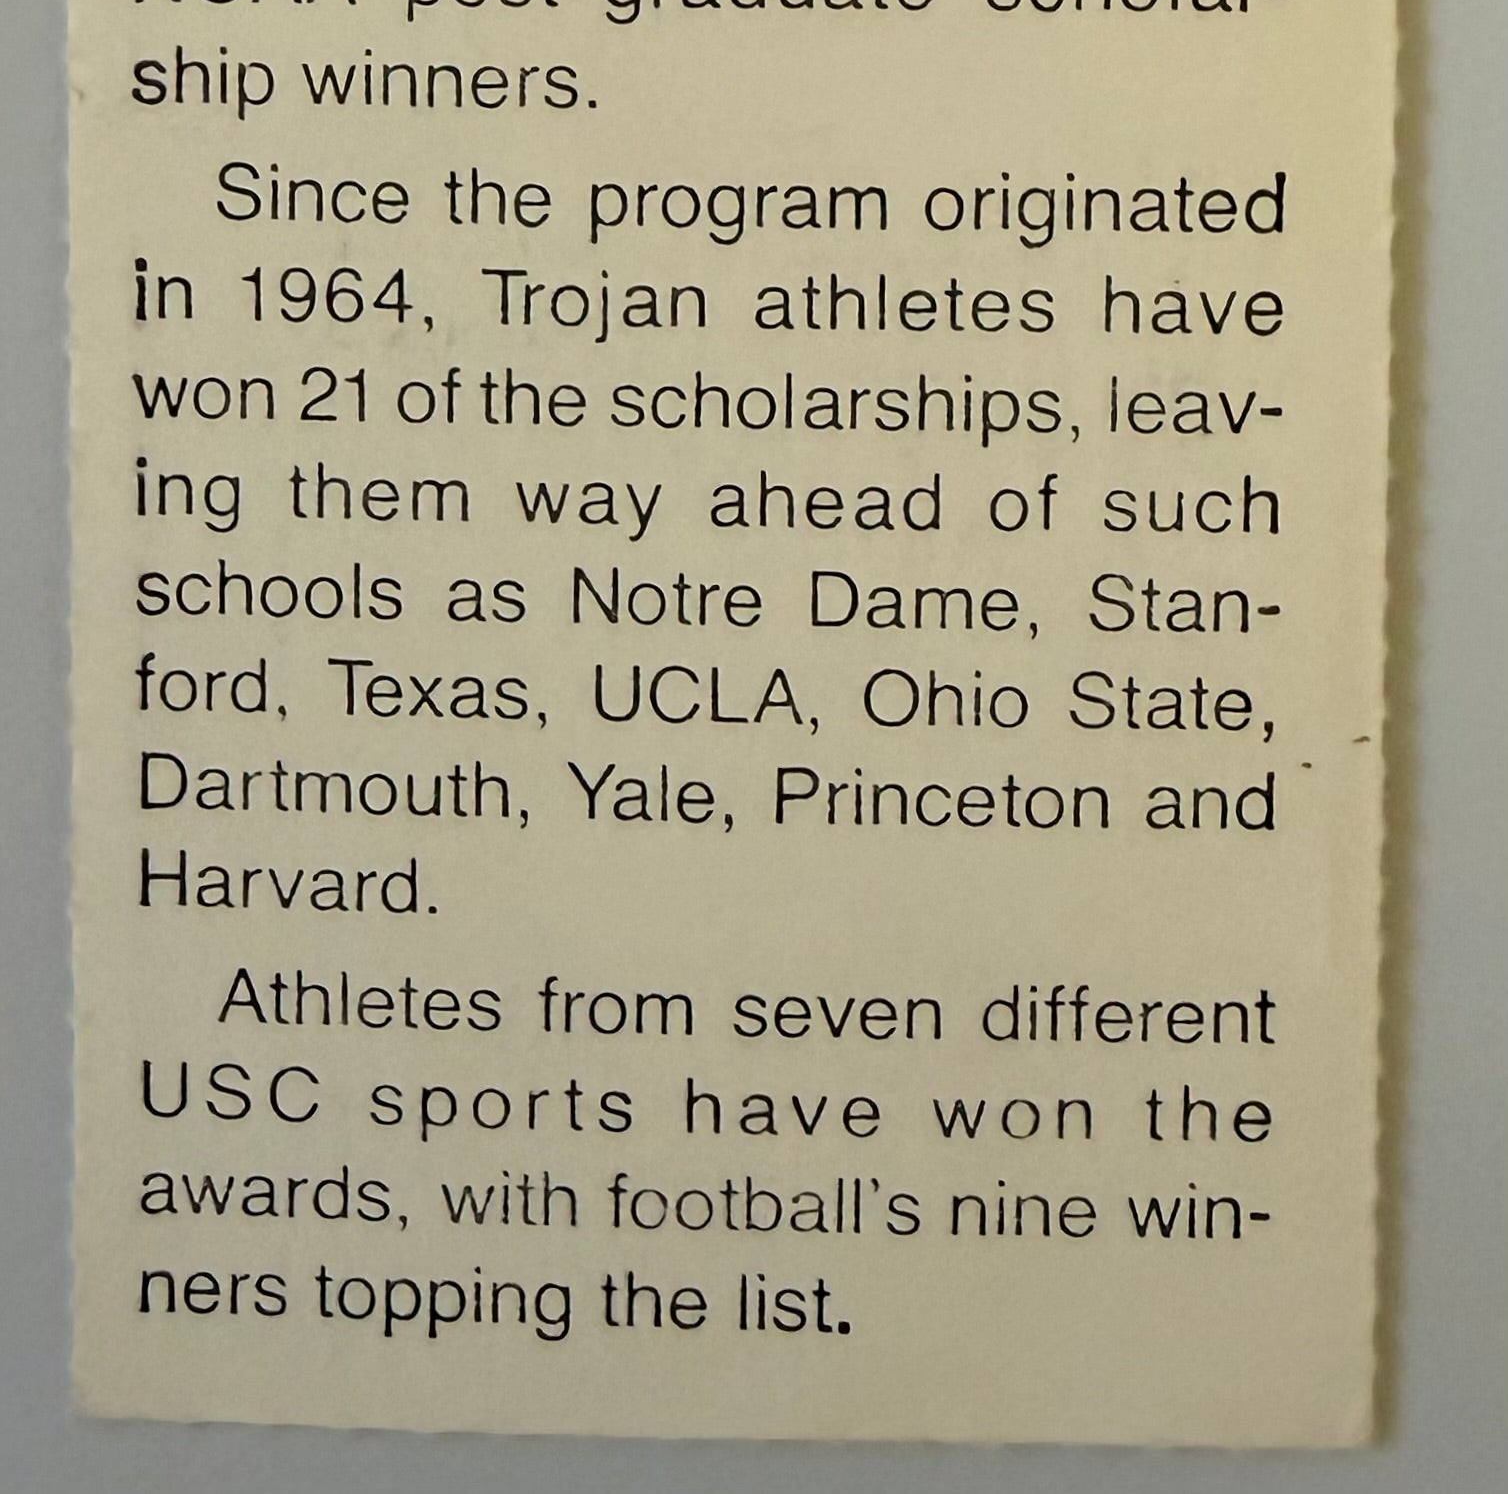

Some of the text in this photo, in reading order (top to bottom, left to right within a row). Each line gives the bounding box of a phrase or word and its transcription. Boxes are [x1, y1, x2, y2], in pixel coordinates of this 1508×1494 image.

[131, 44, 597, 121] ship winners.
[216, 161, 1287, 250] Since the program originated
[134, 257, 1284, 344] in 1964, Trojan athletes have
[131, 366, 1283, 449] won 21 of the scholarships, leav-
[135, 456, 1280, 543] ing them way ahead of such
[136, 558, 1281, 640] schools as Notre Dame, Stan-
[134, 651, 1274, 744] ford, Texas, UCLA, Ohio State,
[140, 750, 1275, 834] Dartmouth, Yale, Princeton and
[138, 847, 438, 915] Harvard.
[217, 967, 1277, 1045] Athletes from seven different
[141, 1059, 1272, 1143] USC sports have won the
[140, 1164, 1271, 1240] awards, with football's nine win-
[138, 1264, 851, 1342] ners topping the list.
